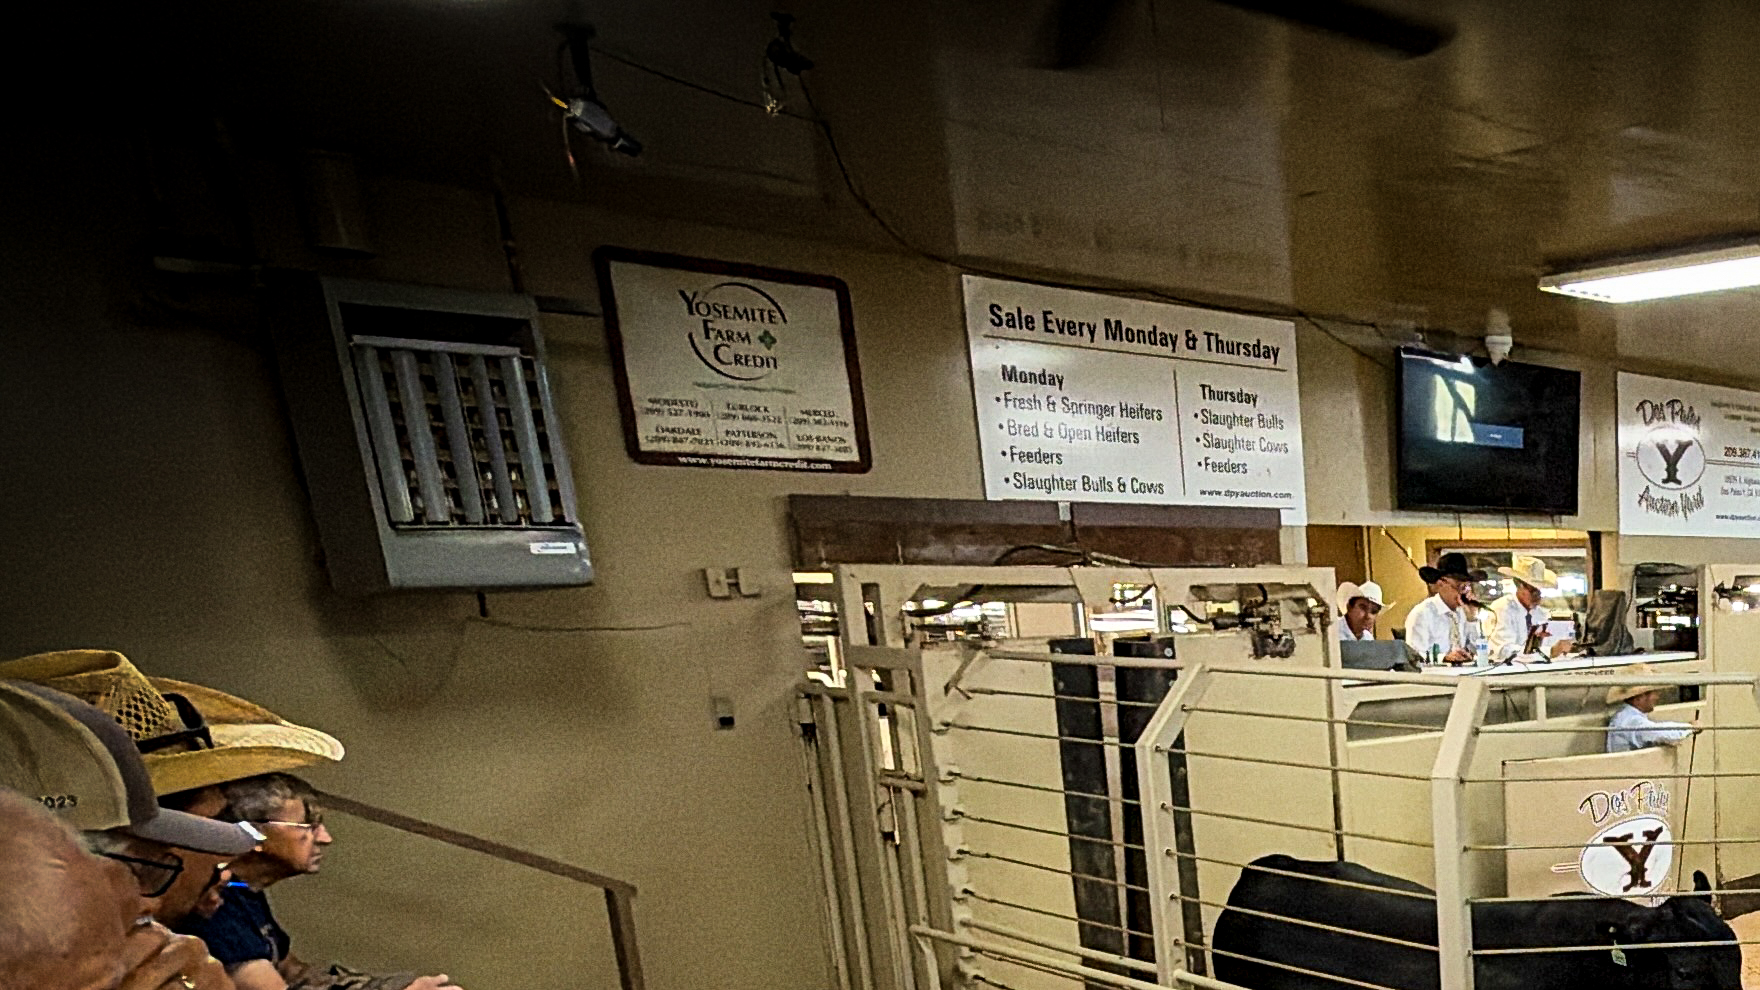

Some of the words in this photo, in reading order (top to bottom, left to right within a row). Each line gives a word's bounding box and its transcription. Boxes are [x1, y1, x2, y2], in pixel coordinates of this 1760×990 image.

[679, 289, 778, 324] YOSEMITE
[702, 319, 751, 345] FARM
[989, 303, 1036, 332] Sale
[1042, 310, 1097, 343] Every
[1104, 318, 1179, 353] Monday
[1184, 330, 1198, 351] &
[1203, 331, 1280, 365] Thursday
[714, 344, 778, 370] CREDIT
[1001, 365, 1064, 390] Monday
[1004, 391, 1042, 412] Fresh
[1047, 395, 1056, 413] &
[1061, 396, 1115, 421] Springer
[1119, 402, 1163, 421] Heifers
[1200, 384, 1258, 407] Thursday
[1201, 409, 1254, 430] Slaughter
[1258, 413, 1284, 430] Bulls
[1007, 420, 1039, 438] Bred
[1044, 422, 1054, 439] &
[1058, 423, 1091, 443] Open
[1096, 426, 1140, 445] Heifers
[1202, 433, 1255, 454] Slaughter
[1259, 436, 1289, 454] Cows
[1010, 445, 1063, 465] Feeders
[1204, 456, 1248, 475] Feeders
[1656, 439, 1693, 486] Y
[1013, 472, 1077, 494] Slaughter
[1082, 475, 1113, 493] Bulls
[1117, 477, 1127, 494] &
[1131, 478, 1164, 495] Cows
[1200, 488, 1292, 500] www.dpyauction.com
[36, 794, 78, 809] 023
[1579, 791, 1628, 824] Dos
[1603, 826, 1664, 893] Y
